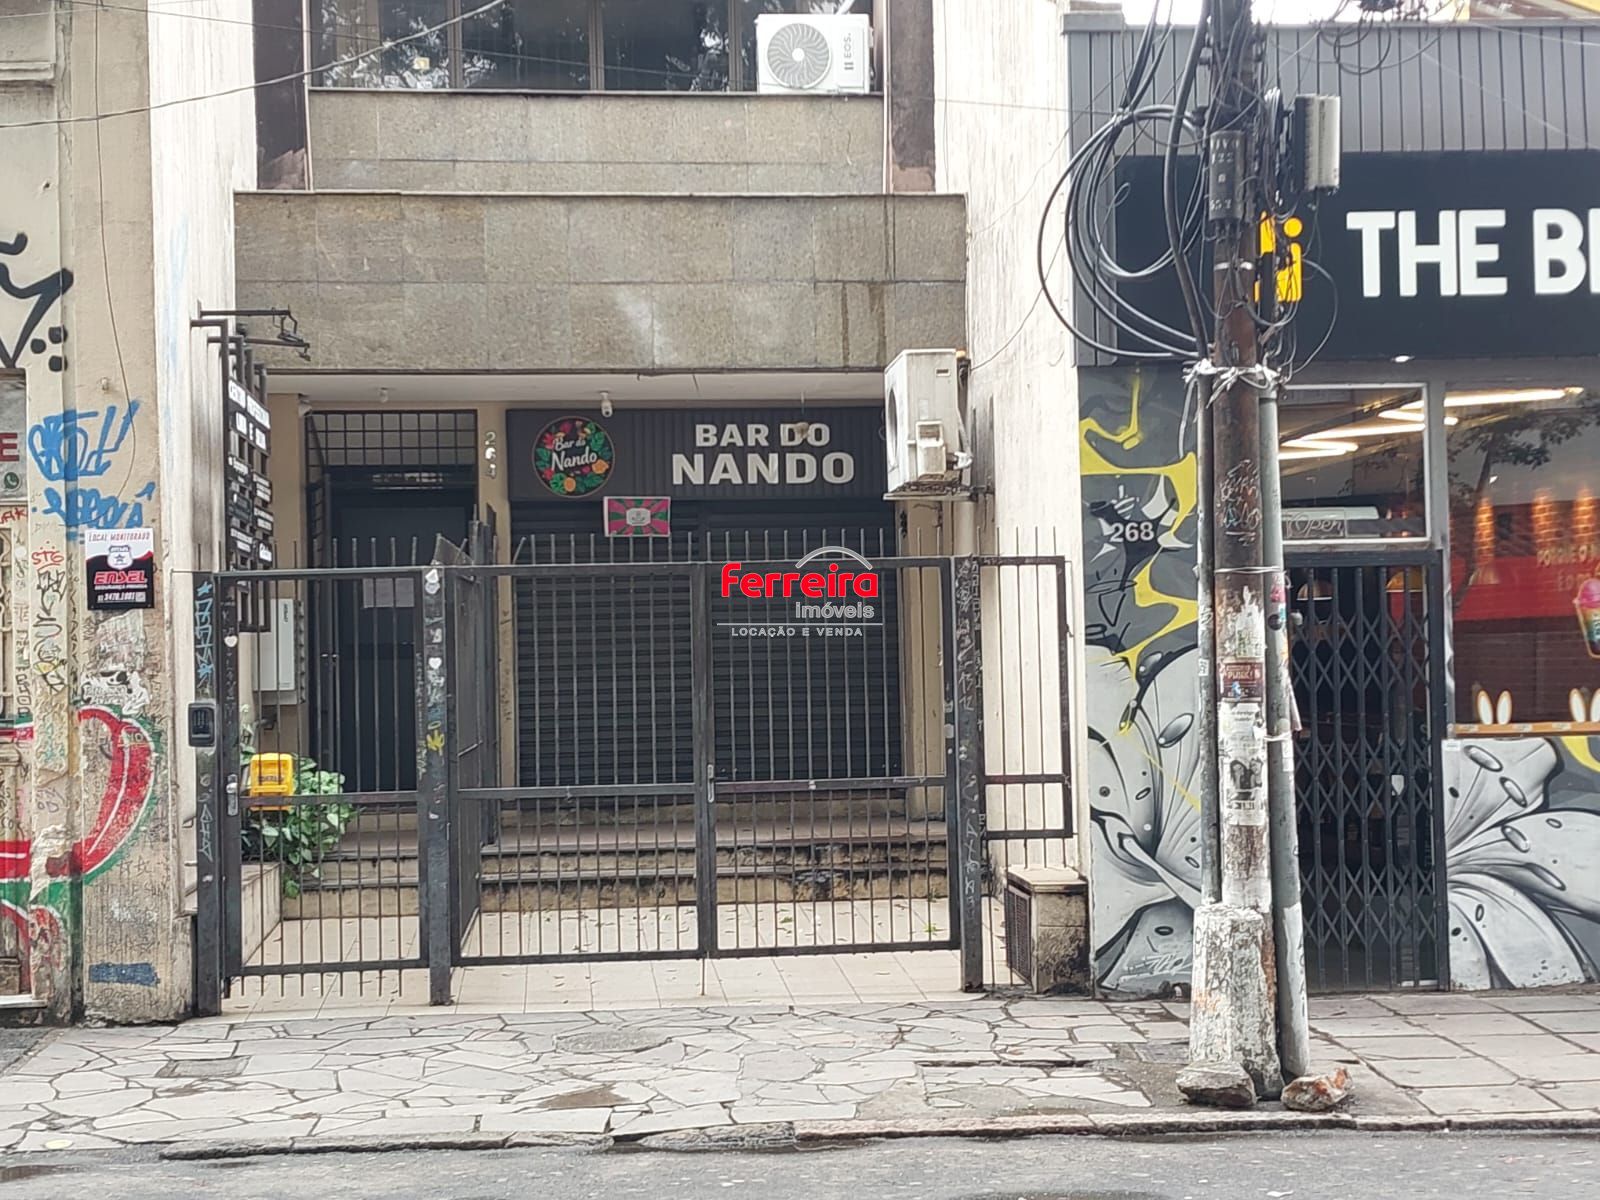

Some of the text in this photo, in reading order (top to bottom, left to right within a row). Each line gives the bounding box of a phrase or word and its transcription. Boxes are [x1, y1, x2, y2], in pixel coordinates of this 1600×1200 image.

[1346, 208, 1600, 297] THE B
[554, 437, 575, 451] Bar
[695, 423, 830, 447] BAR DO
[552, 446, 597, 471] Nando
[672, 452, 855, 485] NANDO
[88, 533, 107, 542] LOCAL
[1109, 521, 1155, 543] 268
